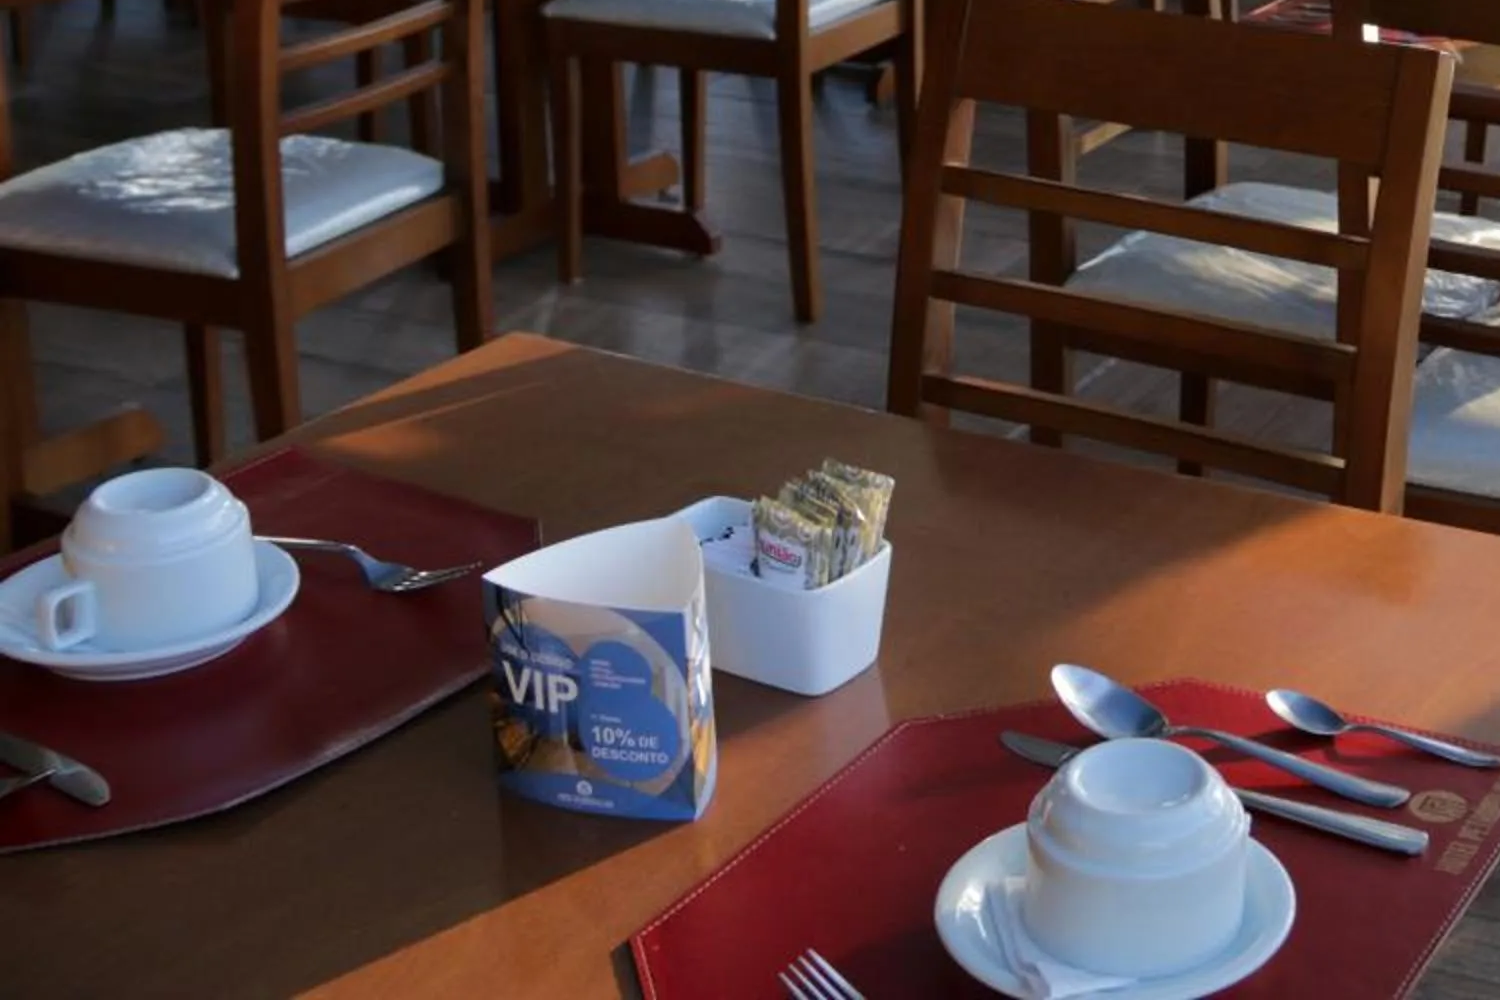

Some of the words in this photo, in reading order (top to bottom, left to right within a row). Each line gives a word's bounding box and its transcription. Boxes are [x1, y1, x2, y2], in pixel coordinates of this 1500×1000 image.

[501, 660, 578, 713] VIP
[592, 726, 635, 747] 10%
[639, 736, 659, 749] DE
[592, 746, 668, 764] DESCONTO
